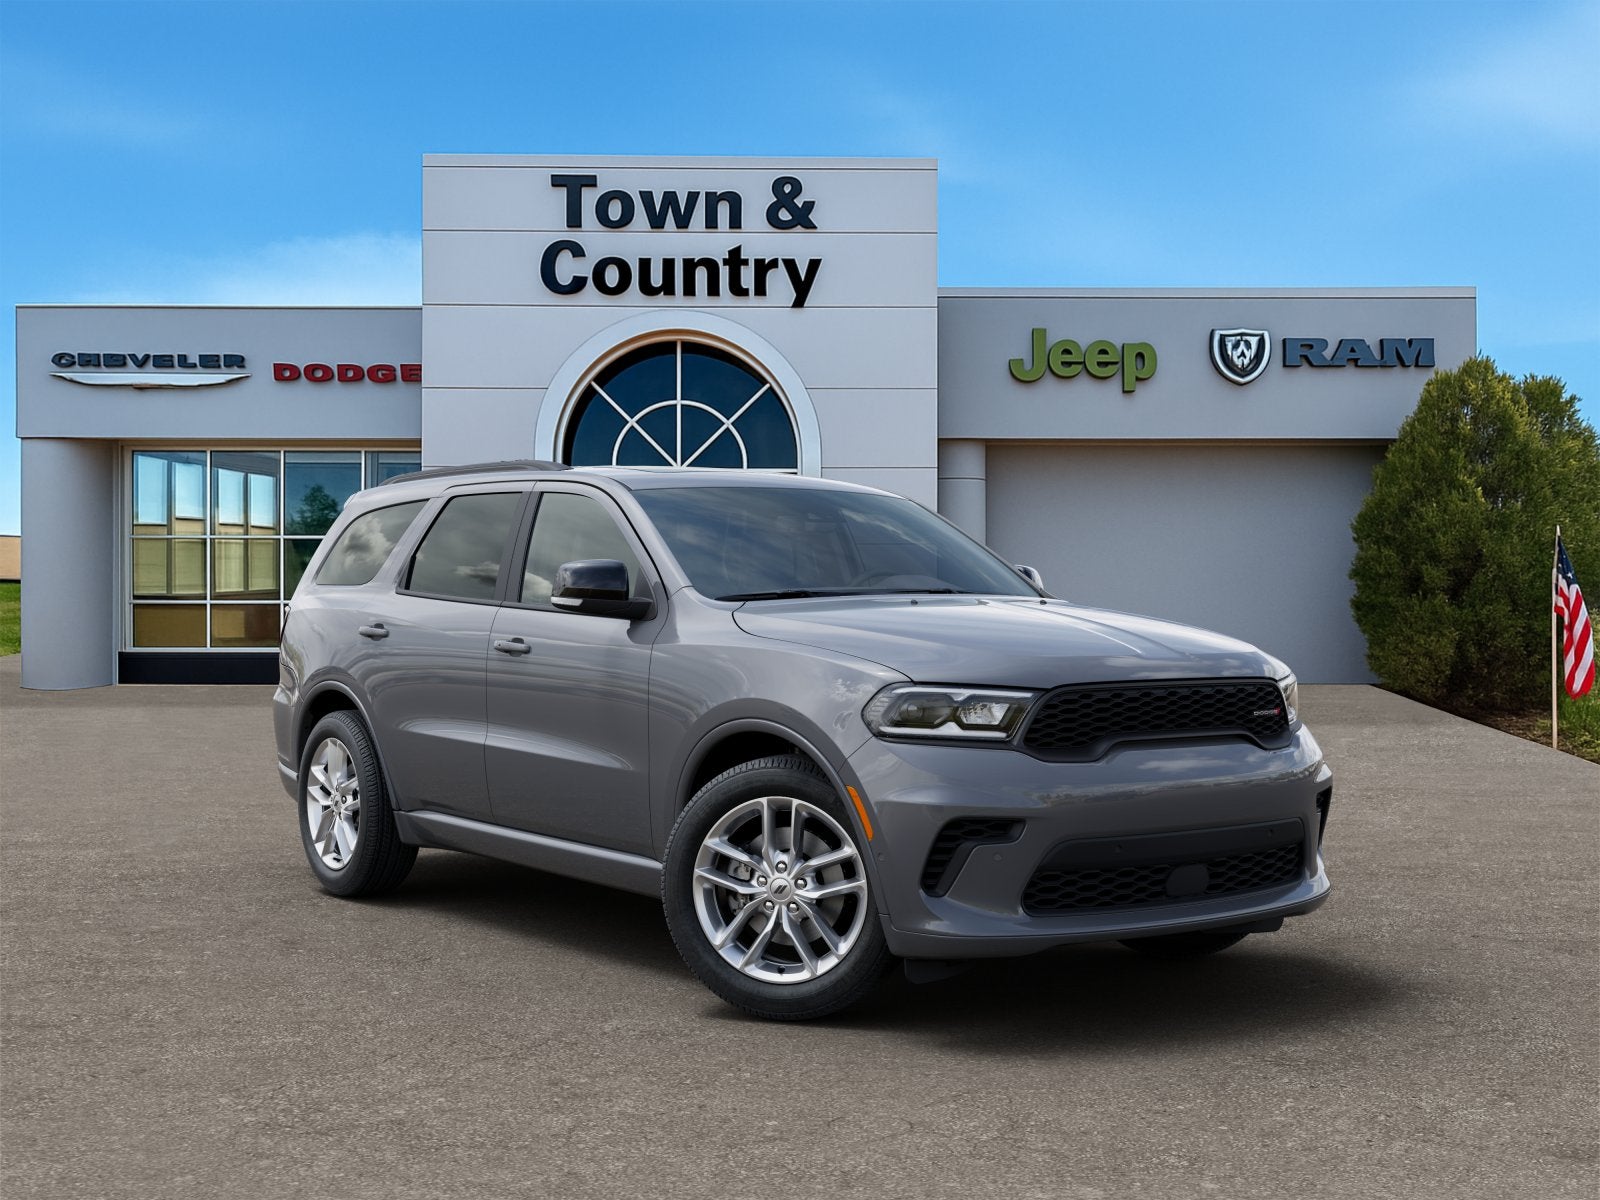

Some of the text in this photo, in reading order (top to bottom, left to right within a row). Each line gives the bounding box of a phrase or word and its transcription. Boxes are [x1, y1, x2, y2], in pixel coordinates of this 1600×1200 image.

[550, 174, 818, 230] Town &
[540, 239, 822, 308] Country
[273, 363, 423, 383] DODGE
[1009, 328, 1158, 393] Jeep
[1282, 337, 1436, 368] RAM
